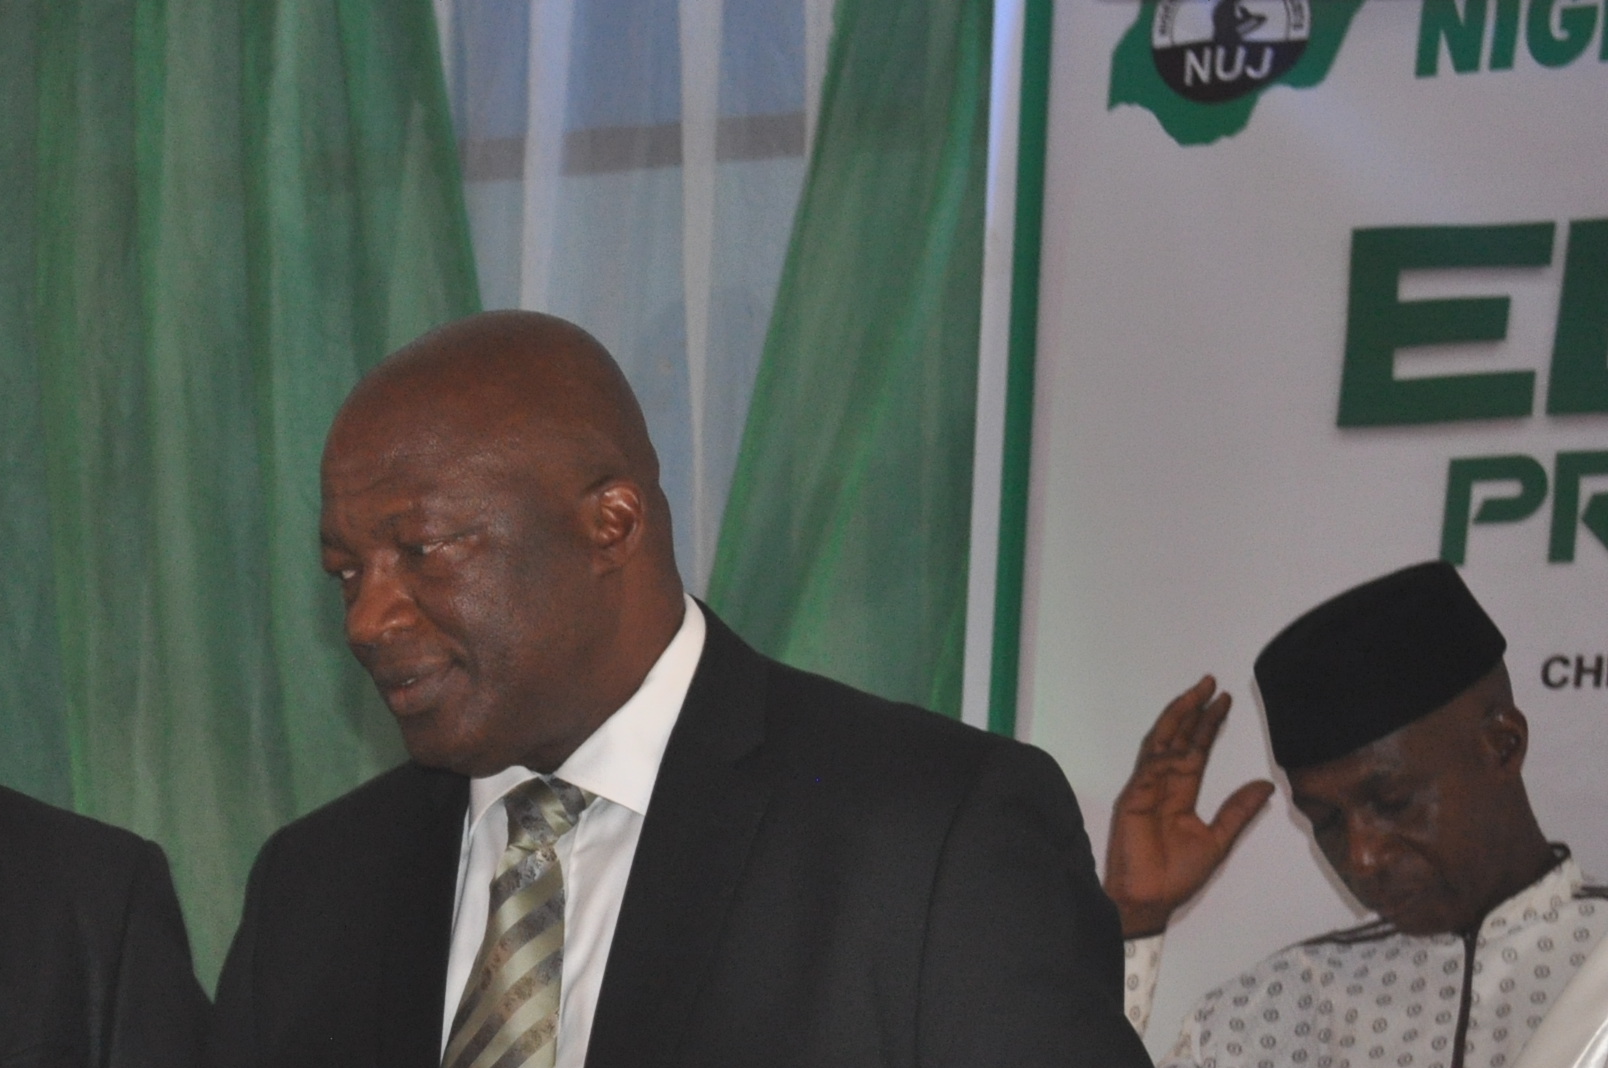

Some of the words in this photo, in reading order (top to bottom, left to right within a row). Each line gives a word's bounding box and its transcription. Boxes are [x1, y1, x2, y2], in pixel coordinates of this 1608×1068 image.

[1183, 45, 1274, 87] NUJ
[1415, 0, 1608, 78] NIG
[1336, 218, 1608, 428] E
[1541, 655, 1608, 689] CH
